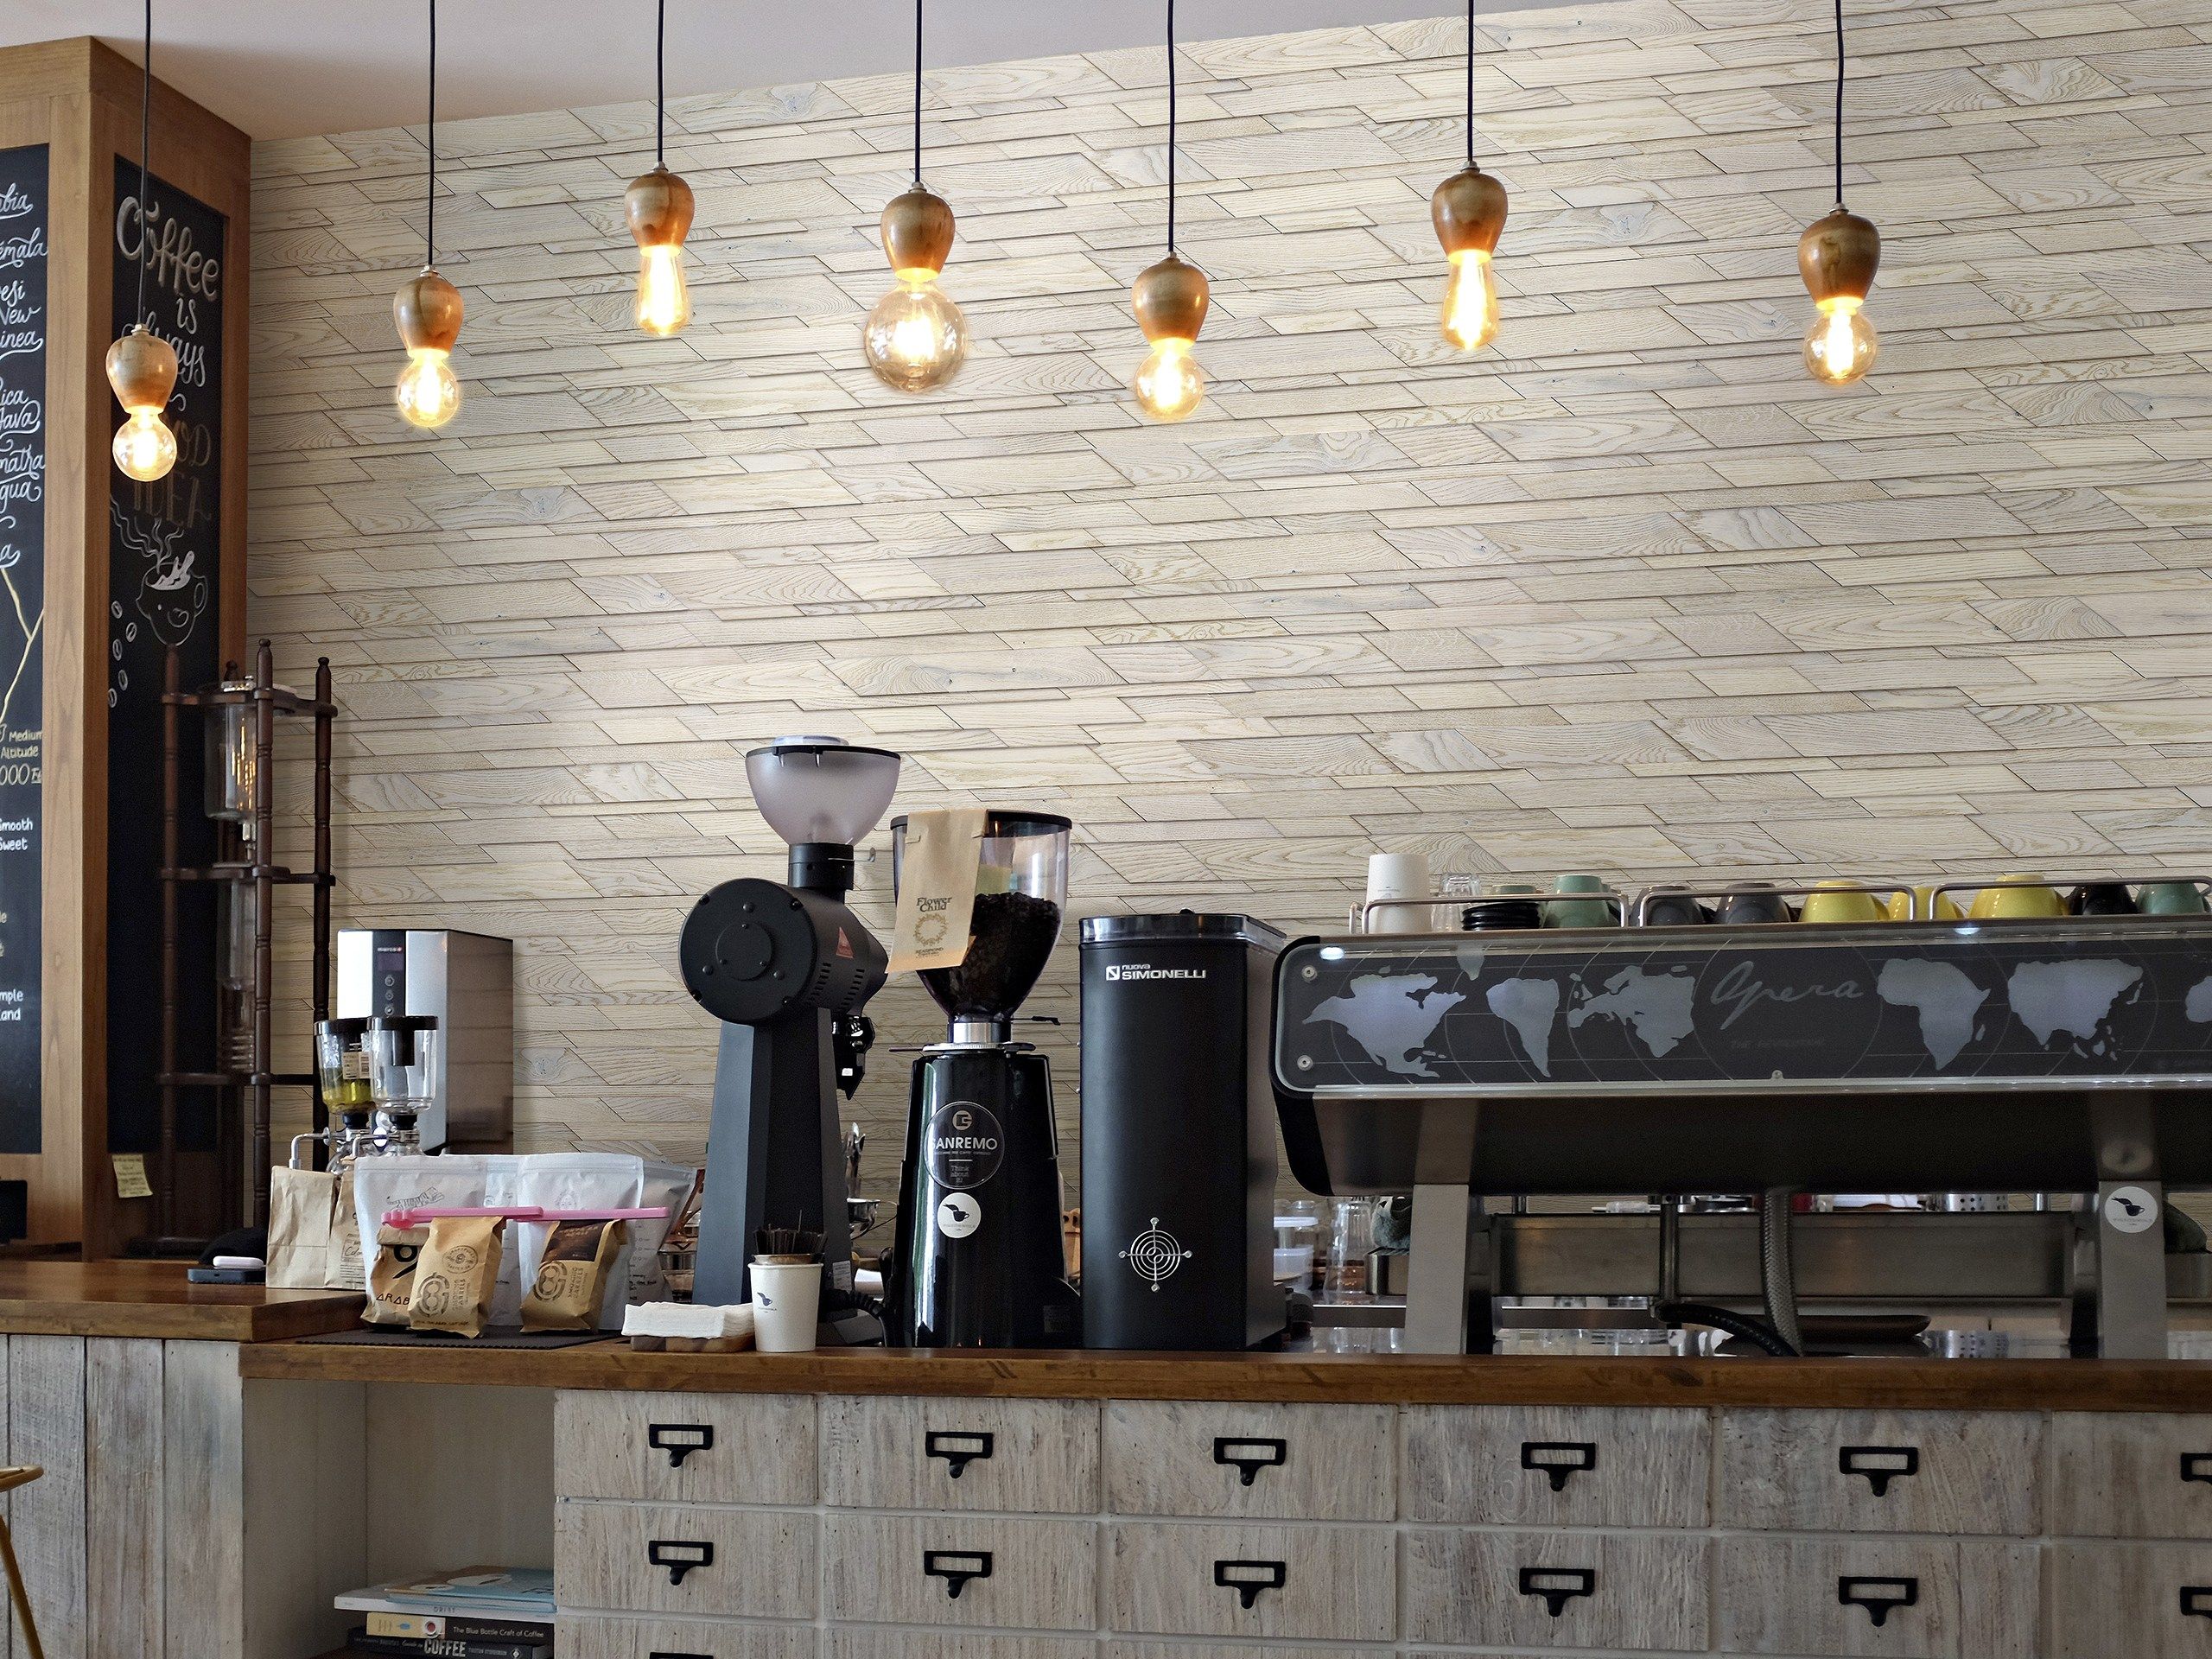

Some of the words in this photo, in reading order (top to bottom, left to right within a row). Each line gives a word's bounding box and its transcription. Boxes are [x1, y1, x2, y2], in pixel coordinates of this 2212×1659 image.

[0, 280, 26, 308] esi
[176, 297, 197, 334] is
[917, 897, 952, 906] Flower
[920, 902, 947, 912] Child
[1122, 969, 1206, 981] SIMONELLI
[1710, 960, 1865, 1031] Opera
[0, 1007, 21, 1021] and
[927, 1136, 998, 1150] ANREMO
[524, 1630, 545, 1639] Coffee
[423, 1638, 467, 1657] COFFEE
